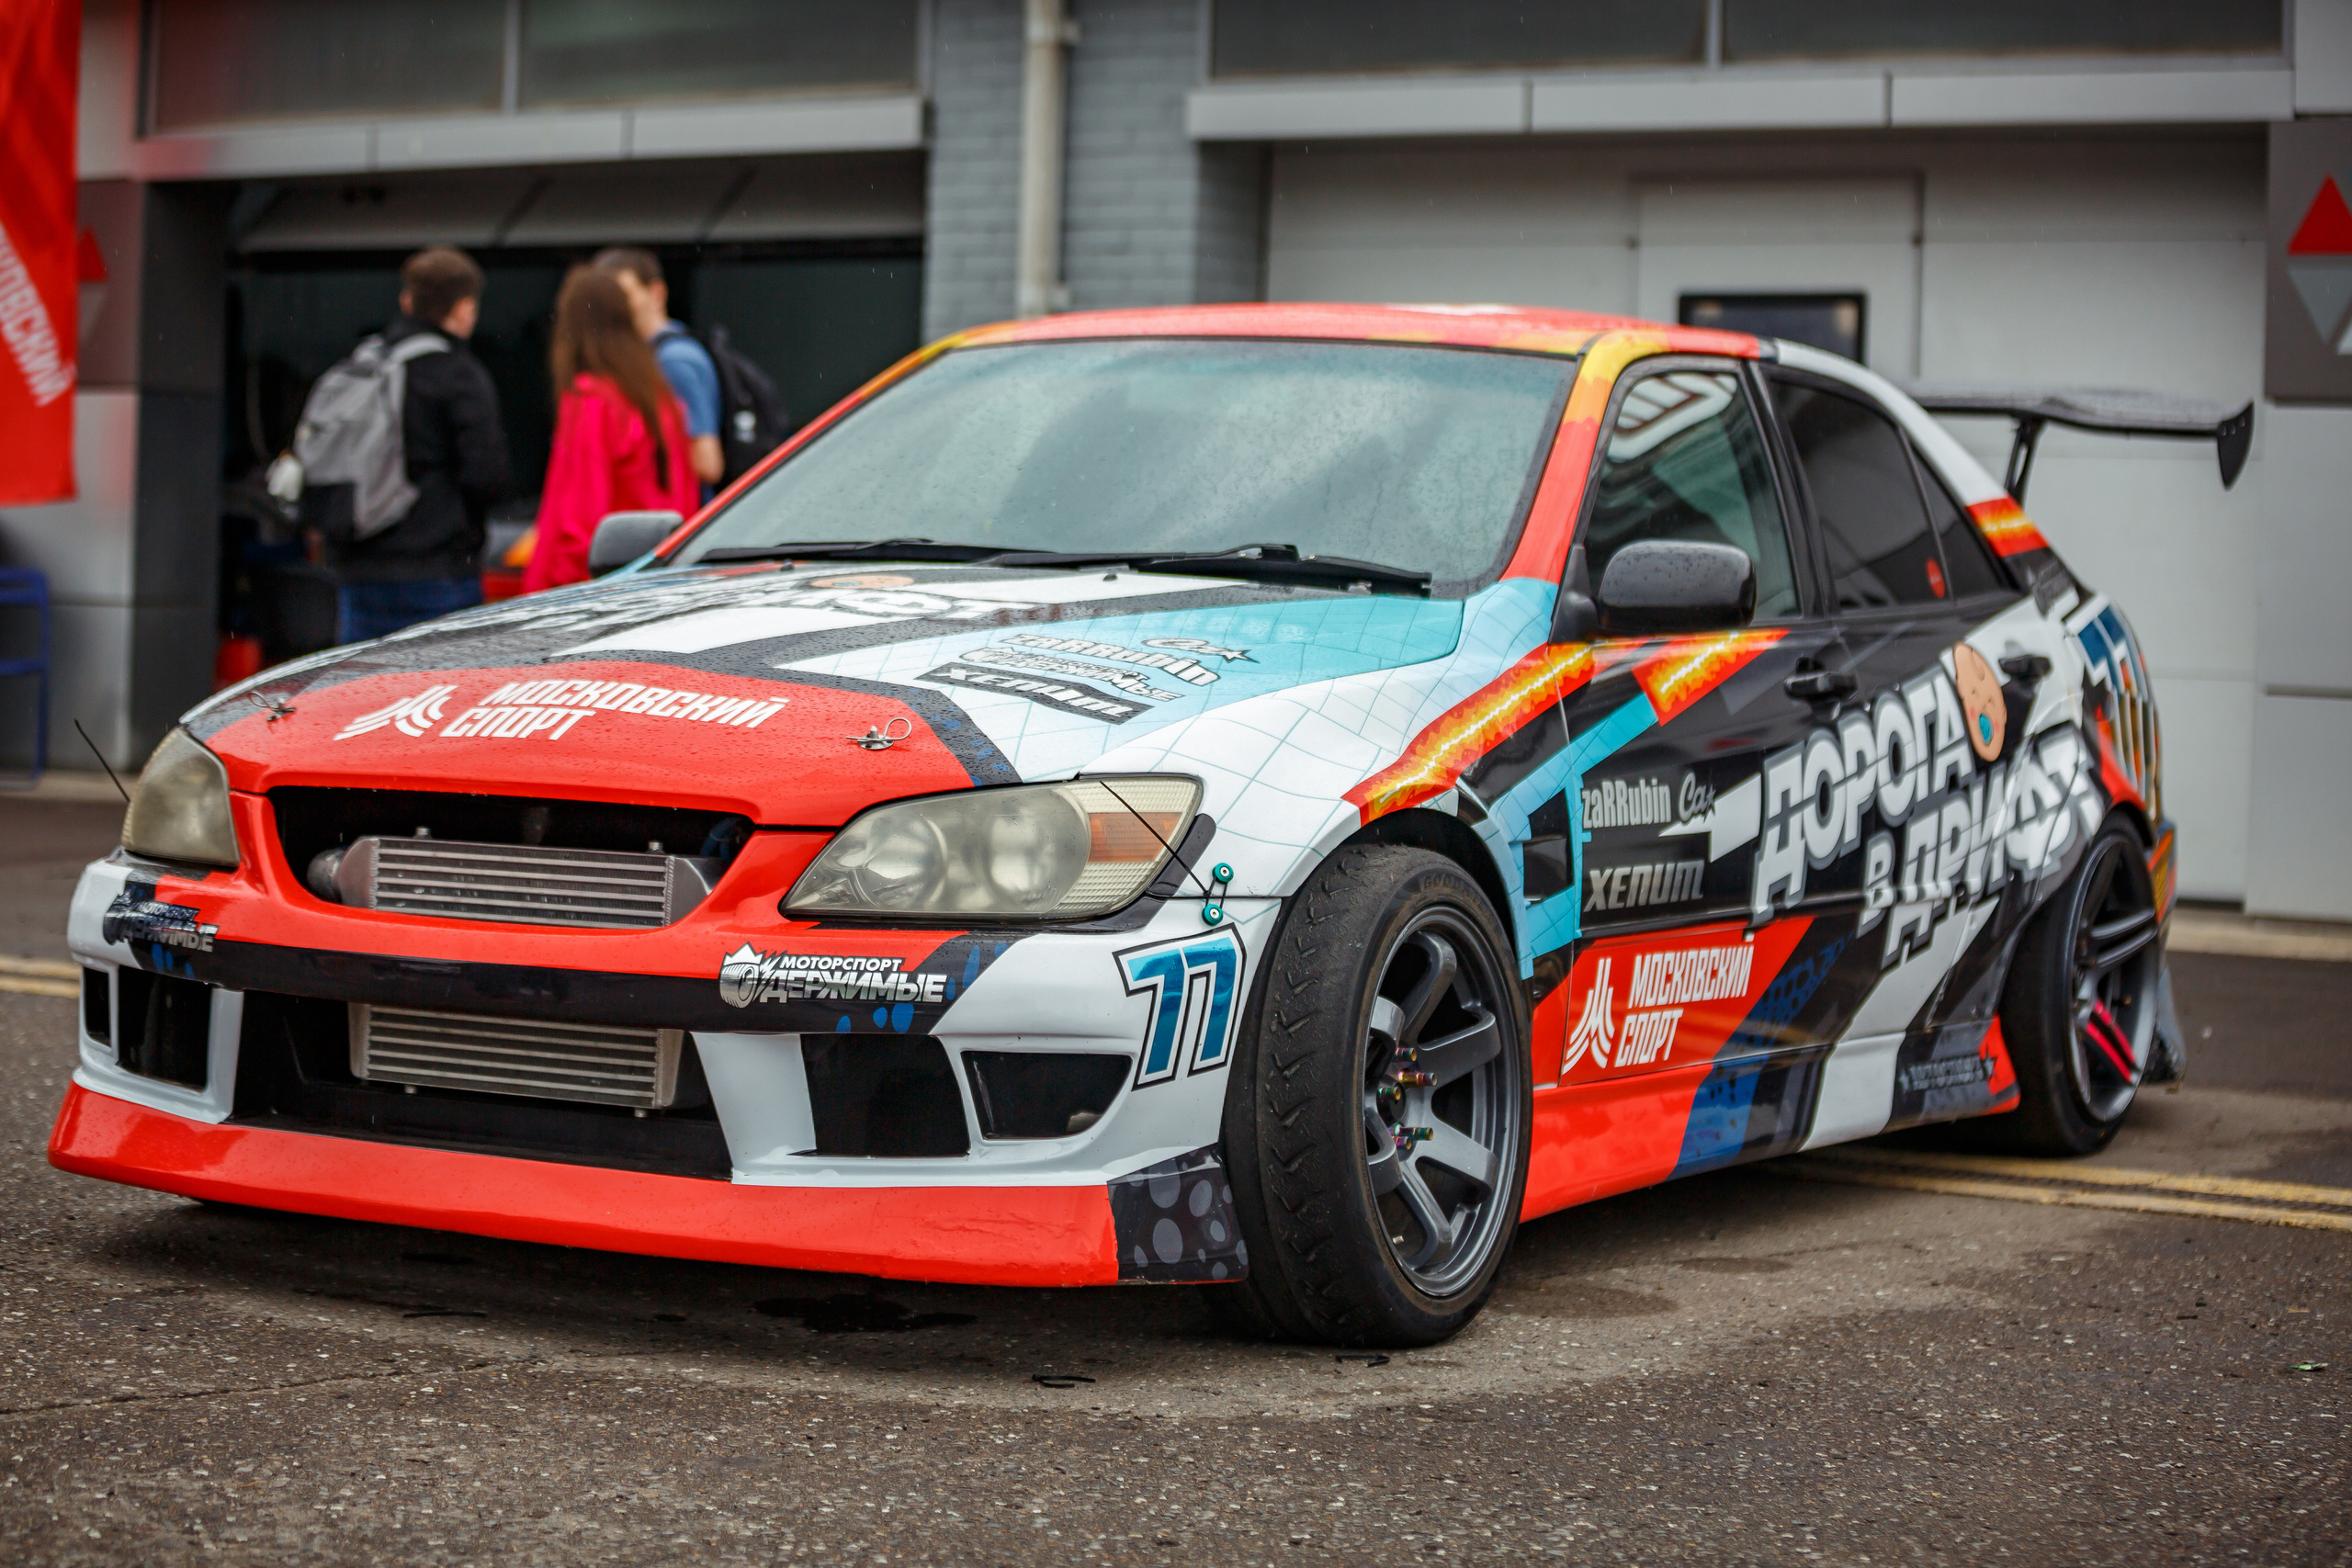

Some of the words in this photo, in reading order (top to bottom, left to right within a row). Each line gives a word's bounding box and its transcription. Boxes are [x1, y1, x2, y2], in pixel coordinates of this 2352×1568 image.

[0, 220, 76, 405] ОВСКИЙ
[439, 706, 596, 740] СПОРТ
[479, 680, 791, 728] МОСКОВСКИЙ
[1581, 778, 1672, 829] zaRRubin
[1753, 673, 1973, 915] ДОРОГА
[1861, 833, 1894, 929] В
[780, 955, 902, 972] МОТОРСПОРТ
[1628, 931, 1754, 1009] МОСКОВСКИЙ
[1113, 923, 1247, 1091] 77
[1614, 1009, 1684, 1068] СПОРТ
